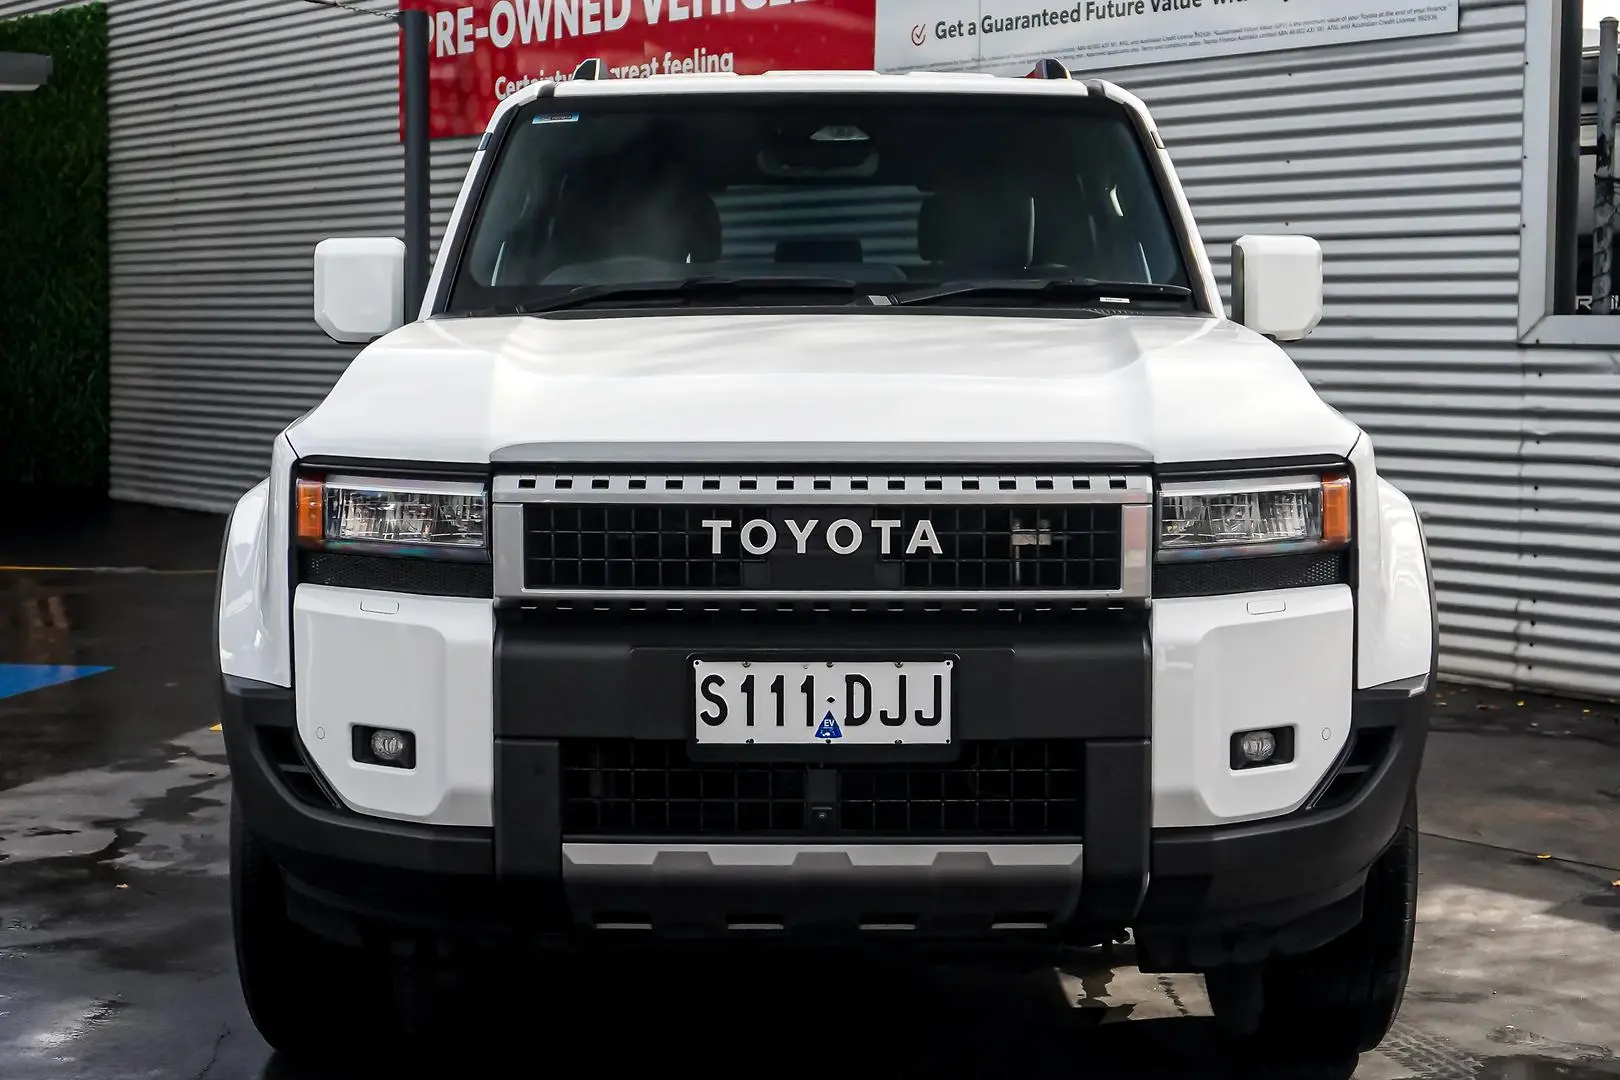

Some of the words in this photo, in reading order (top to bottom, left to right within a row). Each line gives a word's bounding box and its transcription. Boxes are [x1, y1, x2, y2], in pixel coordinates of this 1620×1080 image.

[429, 0, 631, 58] RE-OWNED
[935, 20, 964, 40] Get
[967, 21, 977, 36] a
[981, 2, 1080, 34] Guaranteed
[1086, 1, 1145, 20] Future
[1151, 0, 1202, 13] Value
[662, 47, 734, 75] feeling
[702, 518, 943, 555] TOYOTA
[824, 719, 834, 727] EV
